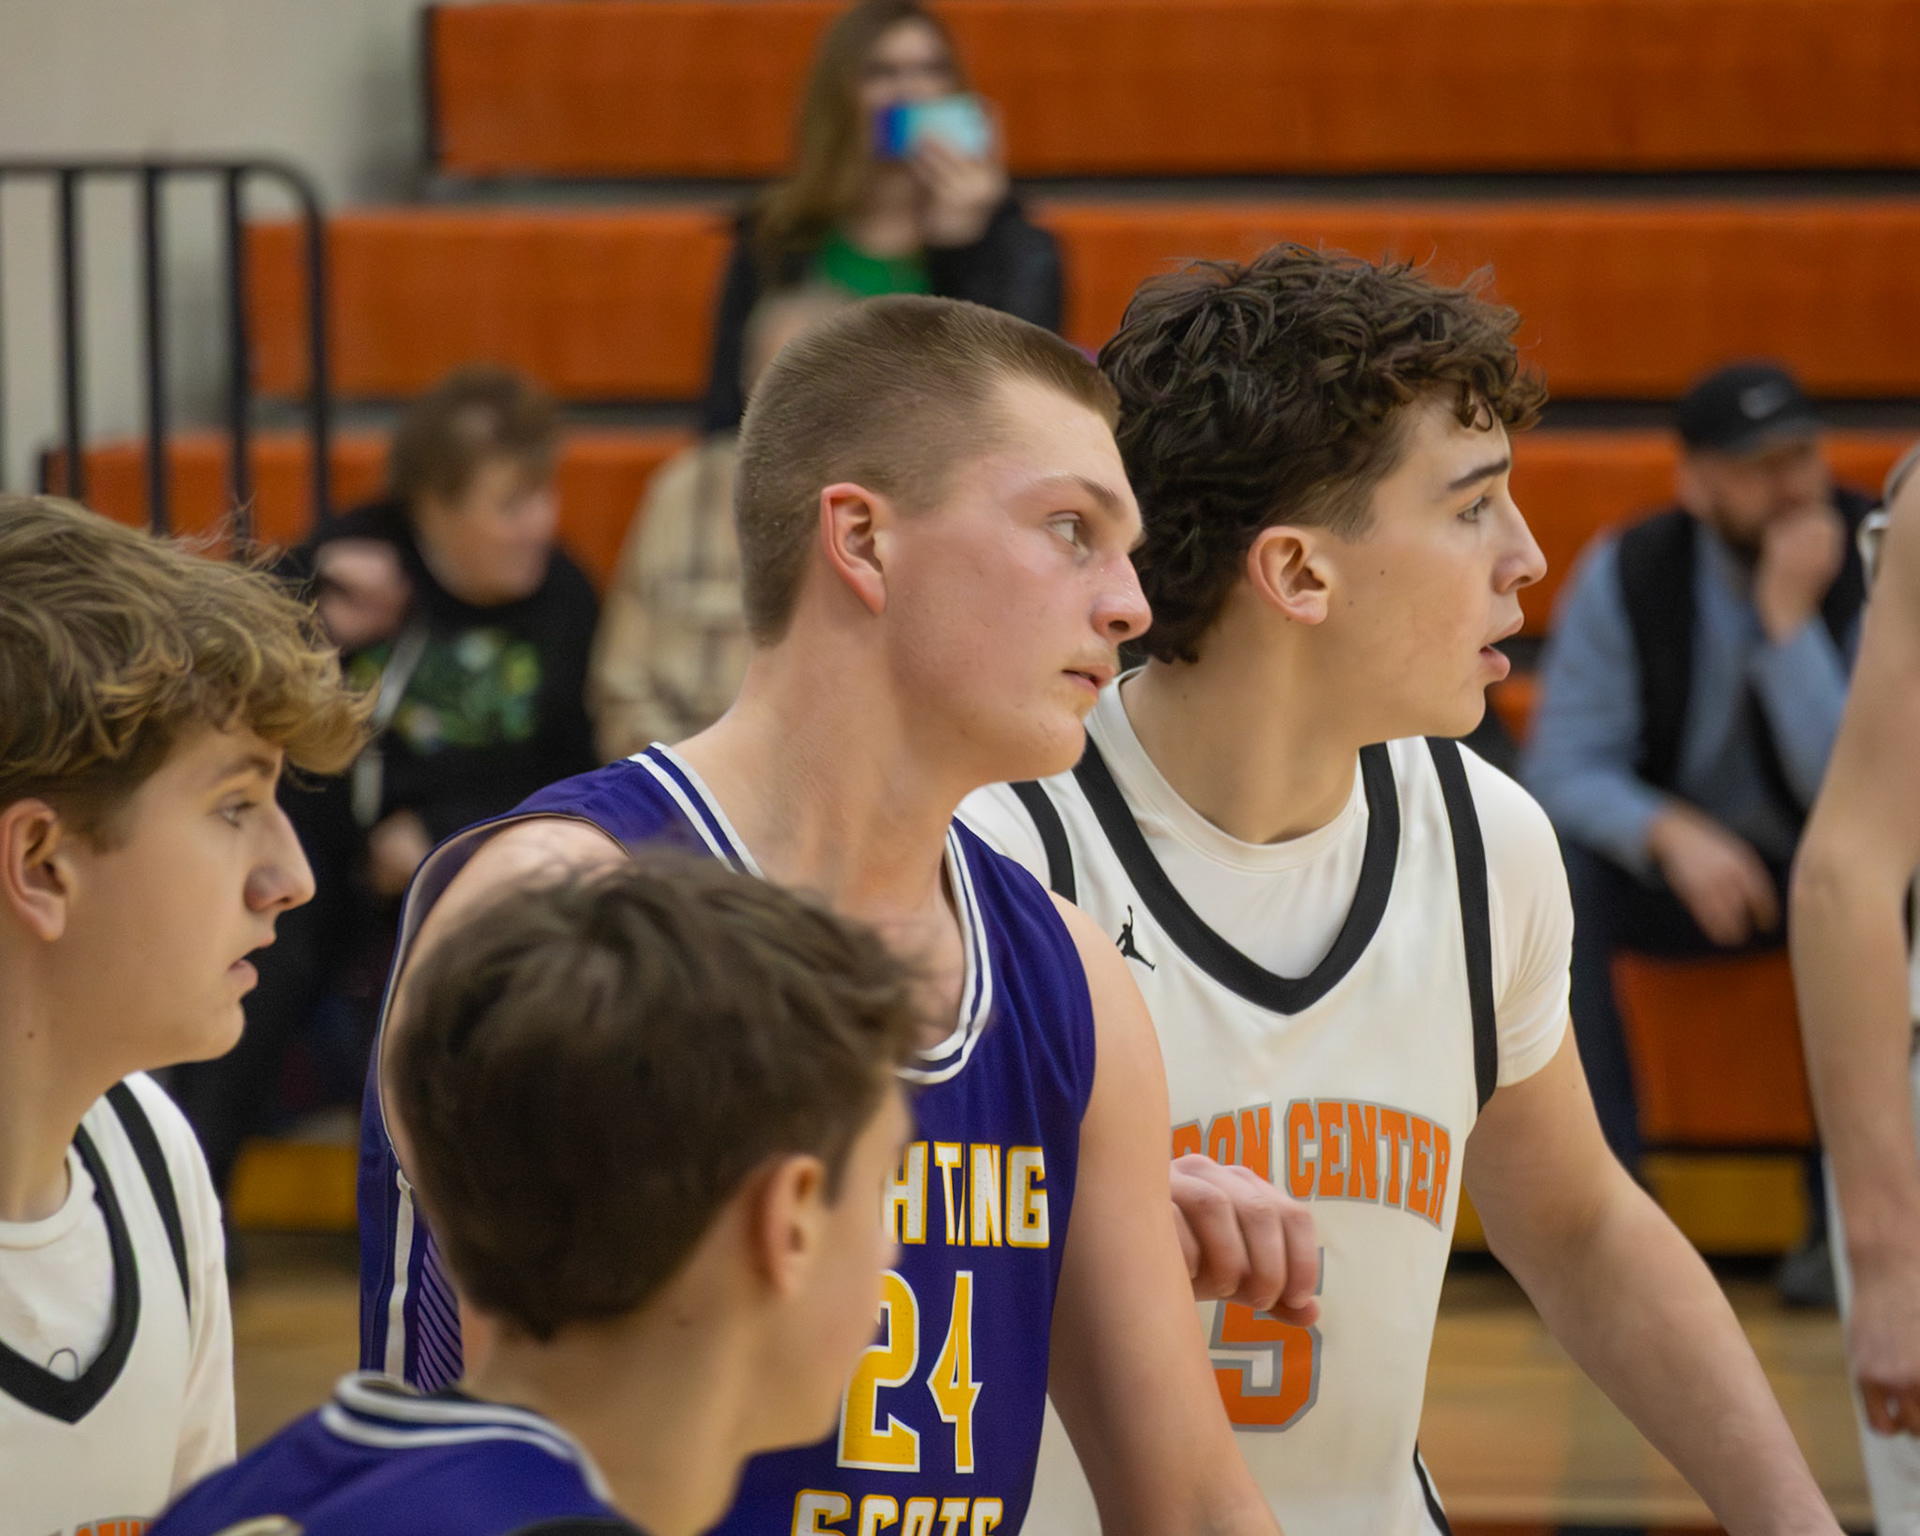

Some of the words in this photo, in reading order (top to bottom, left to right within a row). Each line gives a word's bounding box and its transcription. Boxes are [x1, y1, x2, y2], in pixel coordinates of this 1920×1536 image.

[881, 1141, 1050, 1248] HTNG
[1284, 1098, 1451, 1232] CENTER
[837, 1270, 983, 1474] 24
